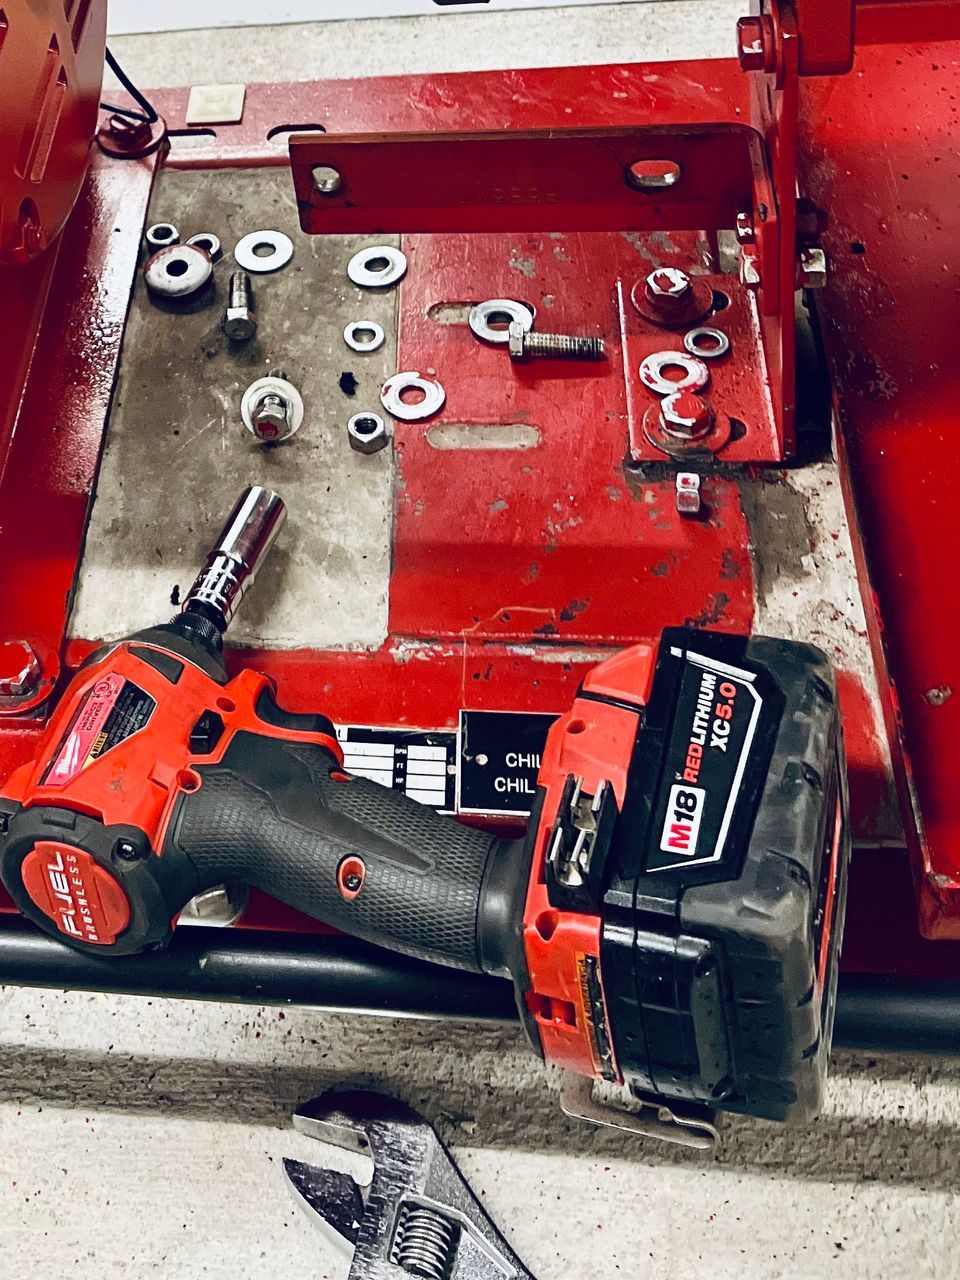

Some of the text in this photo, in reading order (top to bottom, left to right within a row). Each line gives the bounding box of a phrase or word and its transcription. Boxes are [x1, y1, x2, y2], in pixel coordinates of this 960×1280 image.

[683, 671, 717, 784] REDLITHIUM
[710, 682, 737, 752] XC5.0
[667, 789, 698, 850] M18
[47, 851, 82, 937] FUEL
[66, 854, 98, 941] BRUSHLESS
